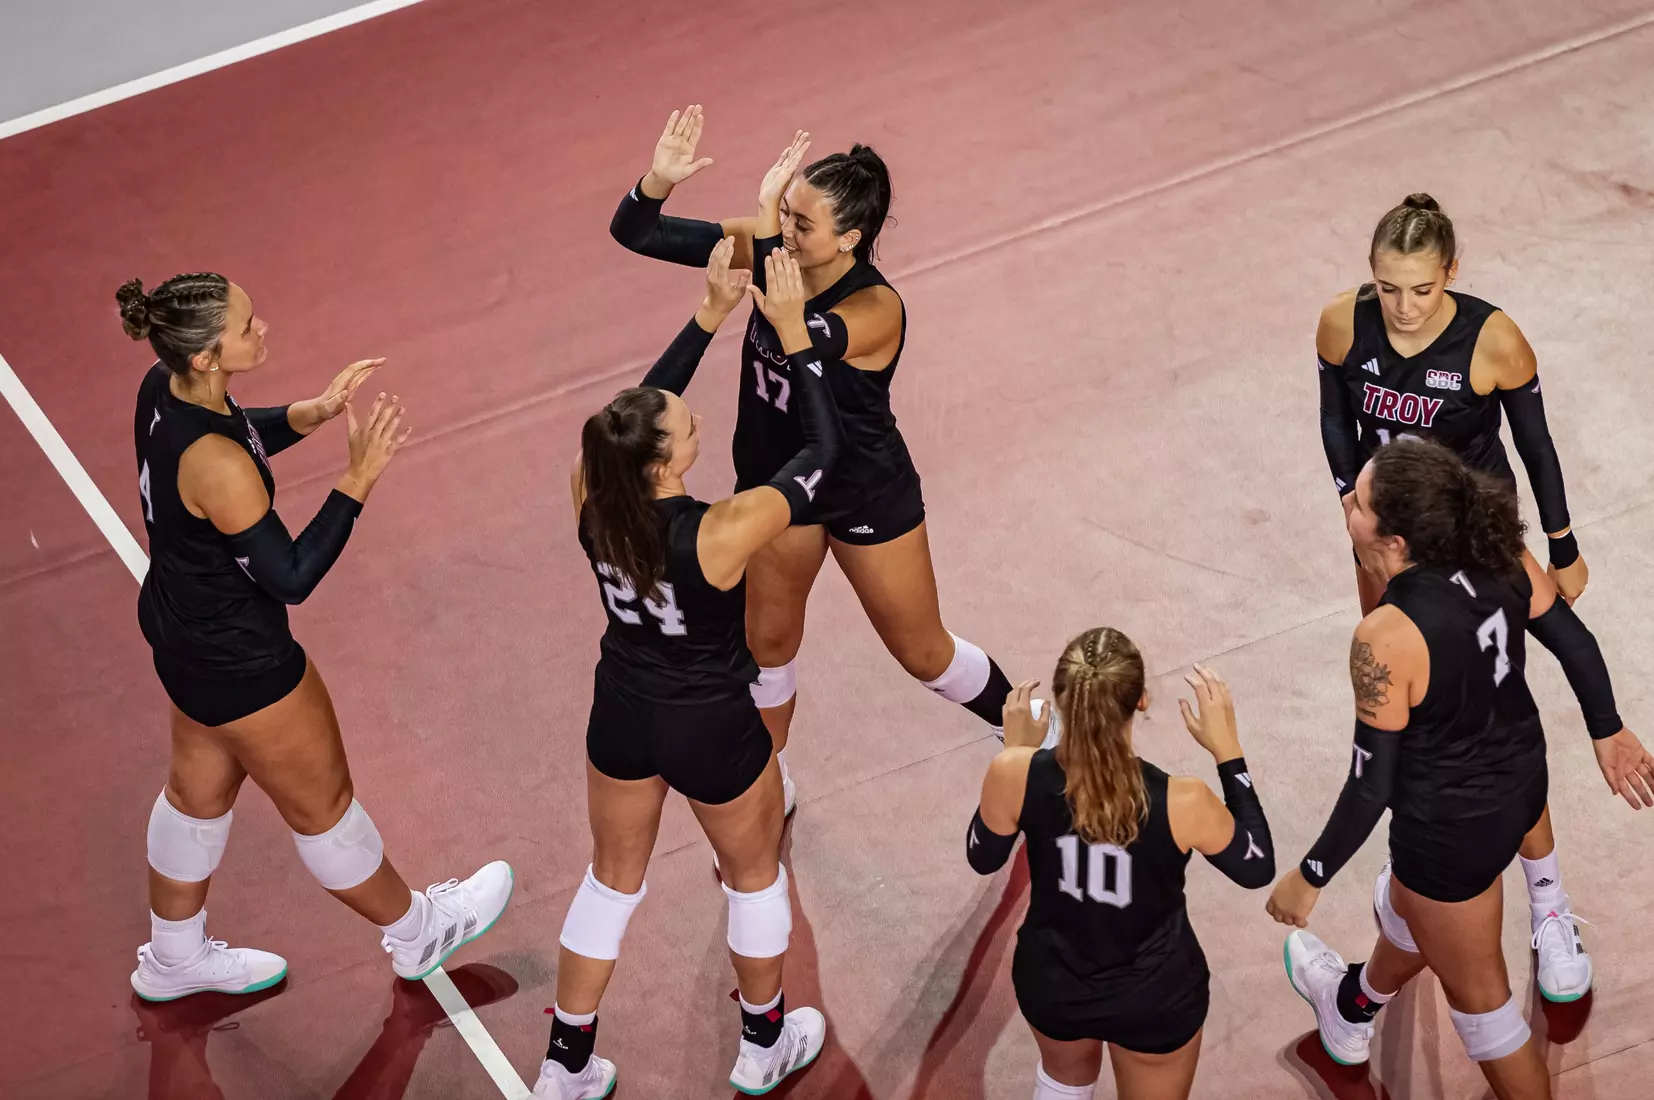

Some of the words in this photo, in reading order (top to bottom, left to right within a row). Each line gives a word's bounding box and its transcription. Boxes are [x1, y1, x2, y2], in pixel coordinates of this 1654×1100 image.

[753, 359, 791, 414] 17
[1362, 382, 1444, 428] TROY
[1425, 368, 1463, 391] SBC
[597, 561, 688, 637] 24
[1476, 607, 1511, 688] 7
[1055, 834, 1133, 910] 10
